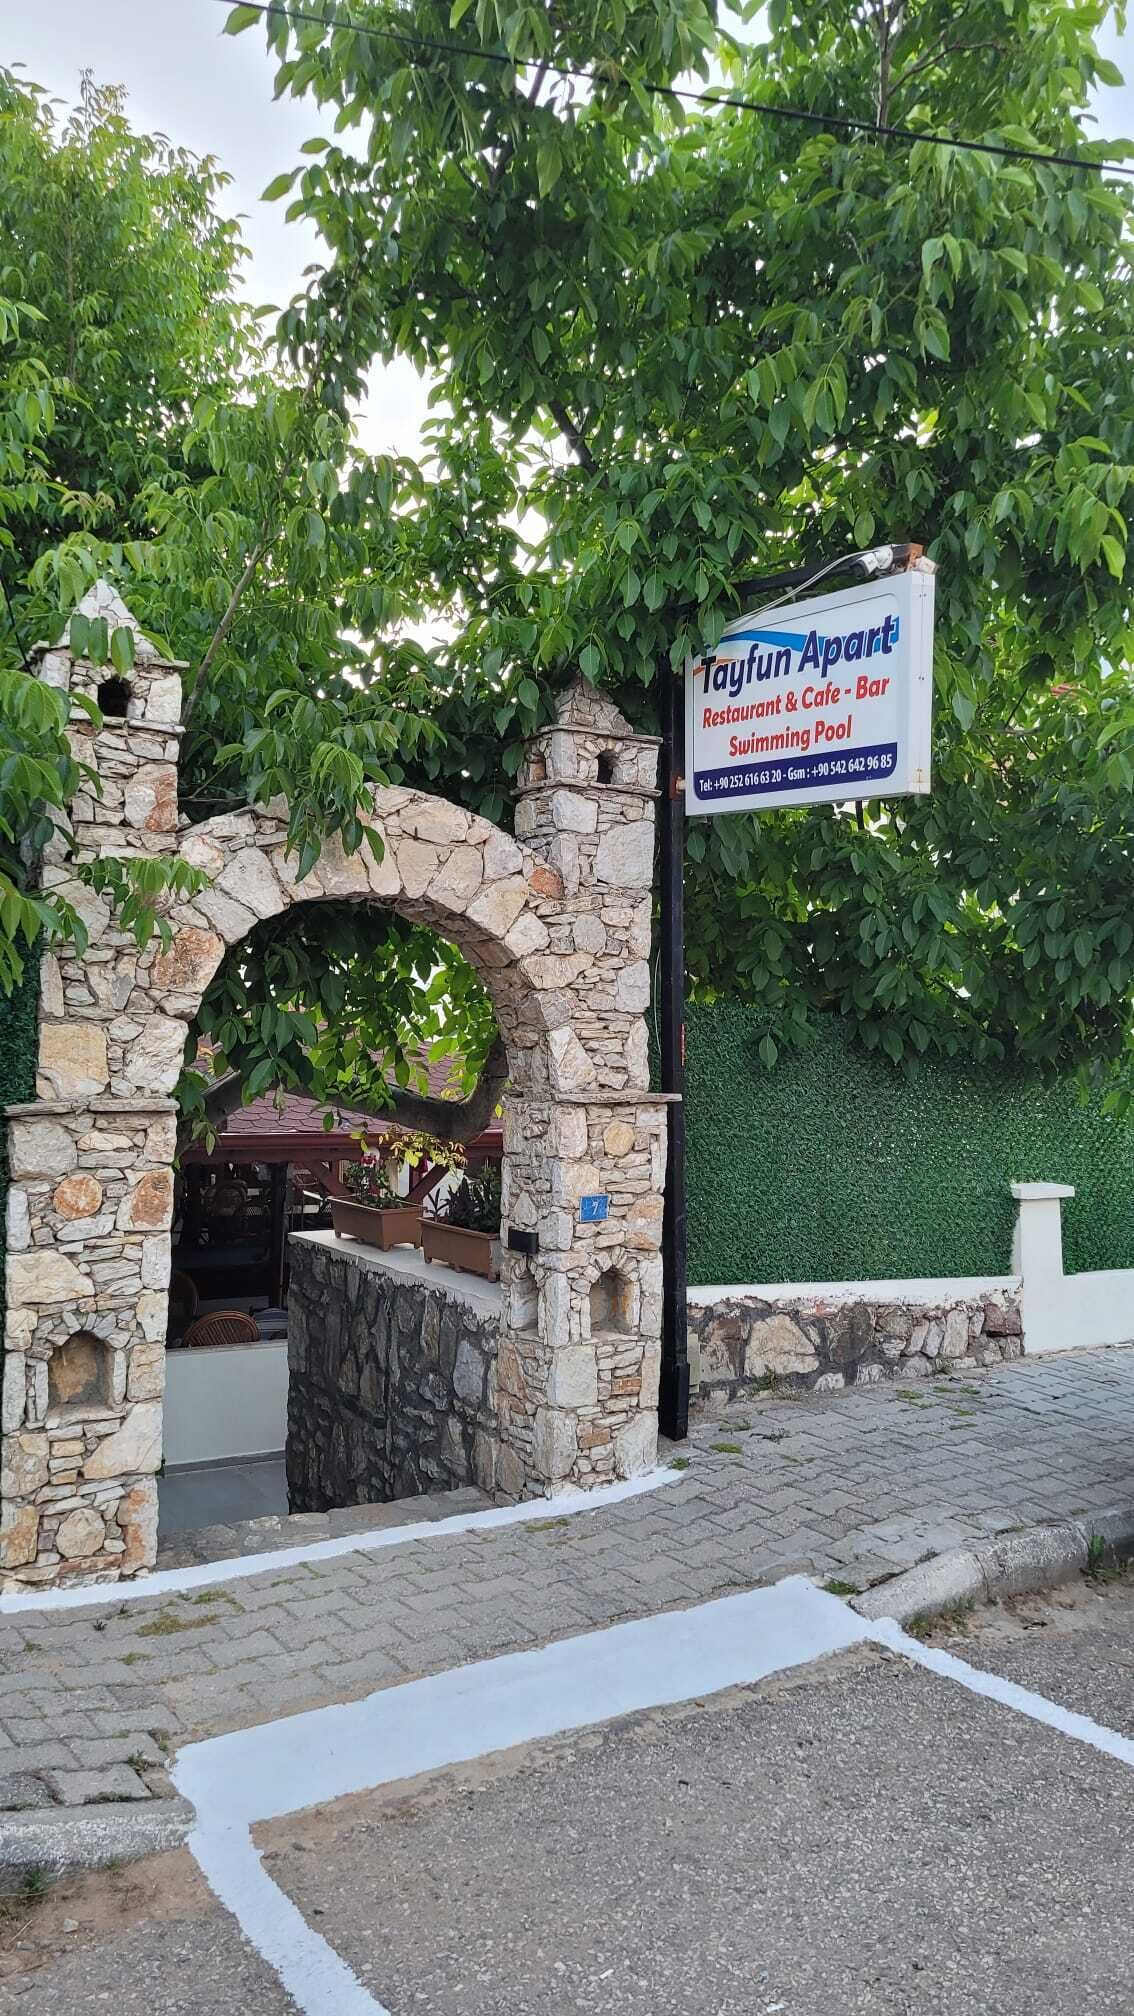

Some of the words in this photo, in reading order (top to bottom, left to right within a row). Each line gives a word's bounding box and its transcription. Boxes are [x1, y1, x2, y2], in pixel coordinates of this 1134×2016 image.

[701, 643, 792, 697] Tayfun
[797, 614, 894, 677] Apart
[703, 695, 781, 728] Restaurant
[785, 691, 798, 712] &
[802, 681, 840, 709] Cafe
[856, 675, 890, 699] Bar
[729, 726, 810, 757] Swimming
[815, 714, 852, 743] Pool
[699, 779, 712, 792] Tel:
[714, 776, 728, 790] +90
[730, 775, 743, 788] 252
[745, 772, 758, 786] 616
[760, 771, 769, 784] 63
[772, 769, 781, 782] 20
[788, 767, 805, 780] Gsm
[811, 763, 828, 777] +90
[830, 760, 846, 775] 542
[848, 757, 865, 772] 642
[867, 755, 879, 770] 96
[880, 754, 892, 768] 85
